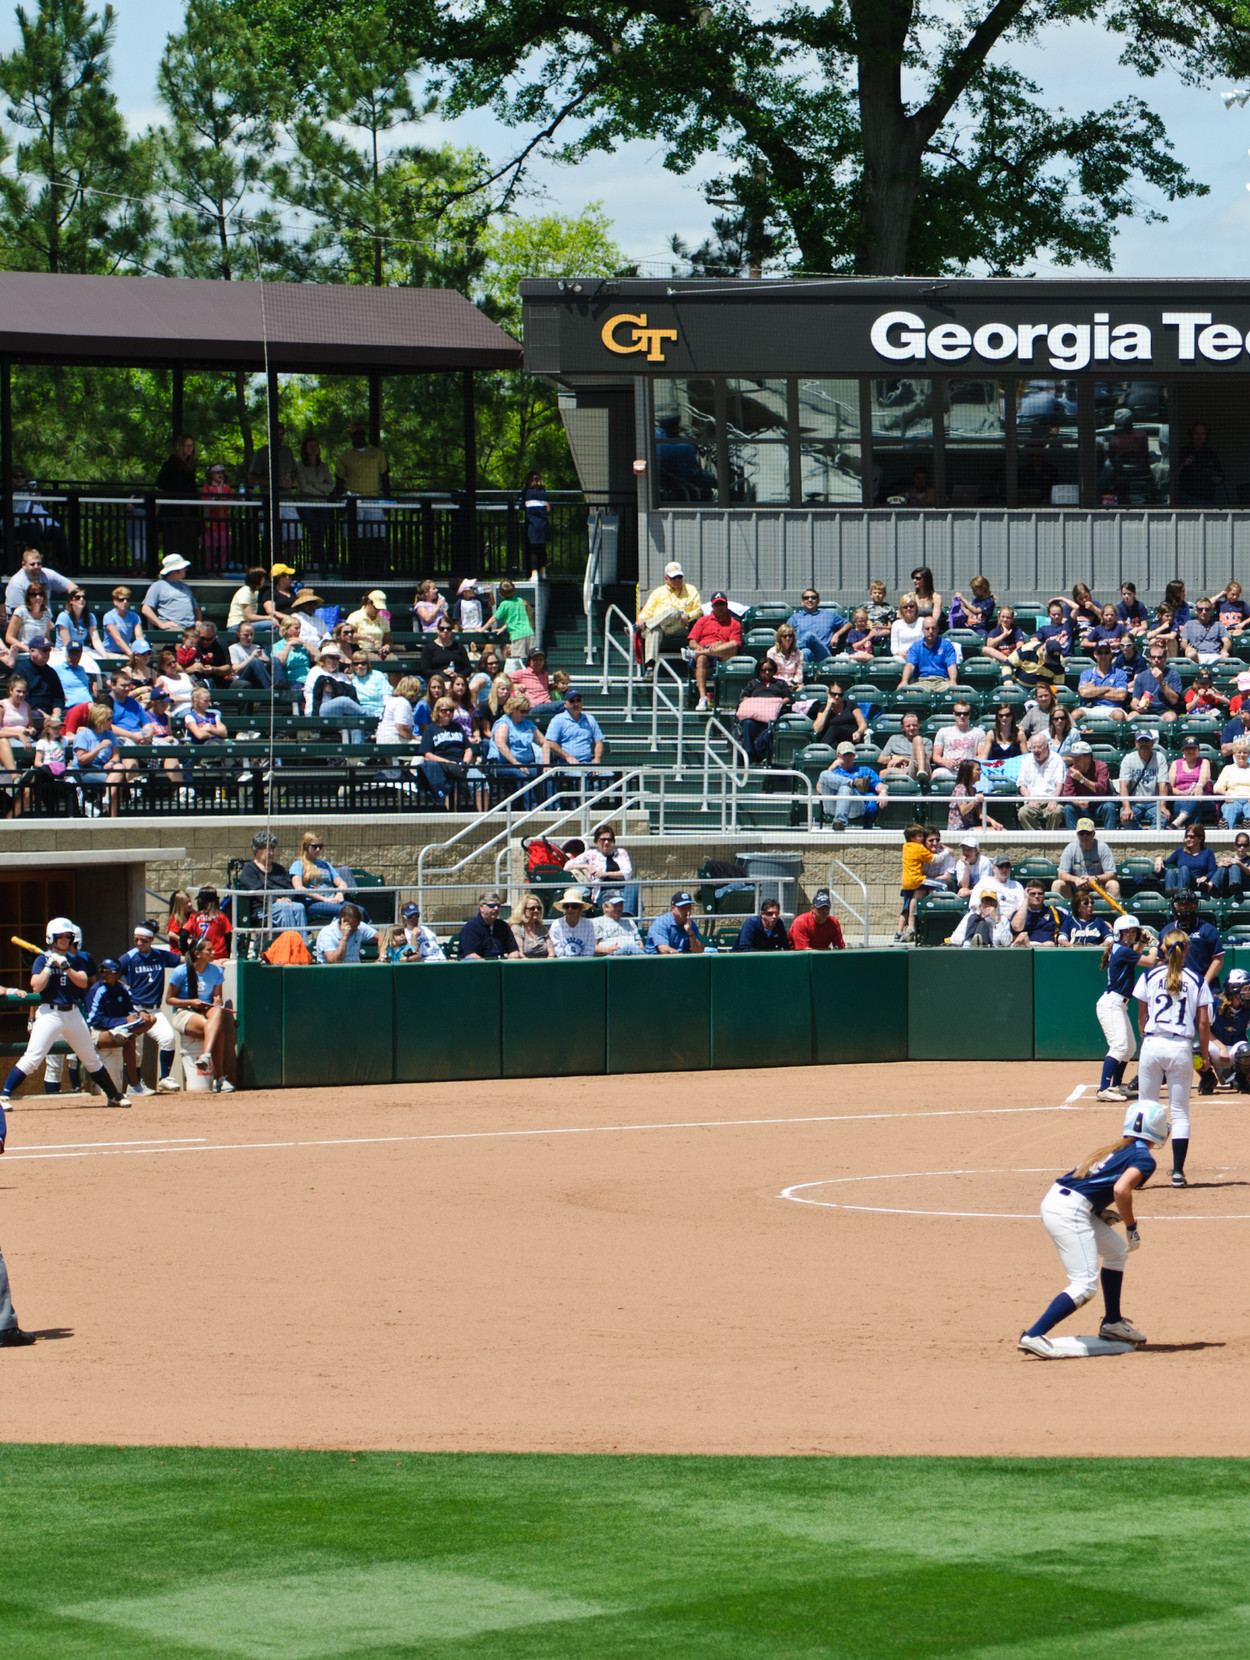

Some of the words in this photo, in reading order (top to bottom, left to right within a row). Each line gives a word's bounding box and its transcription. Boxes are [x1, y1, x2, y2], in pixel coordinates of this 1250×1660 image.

[601, 313, 678, 361] GT
[870, 310, 1152, 371] Georgia
[199, 923, 210, 939] 7
[1155, 994, 1186, 1026] 21
